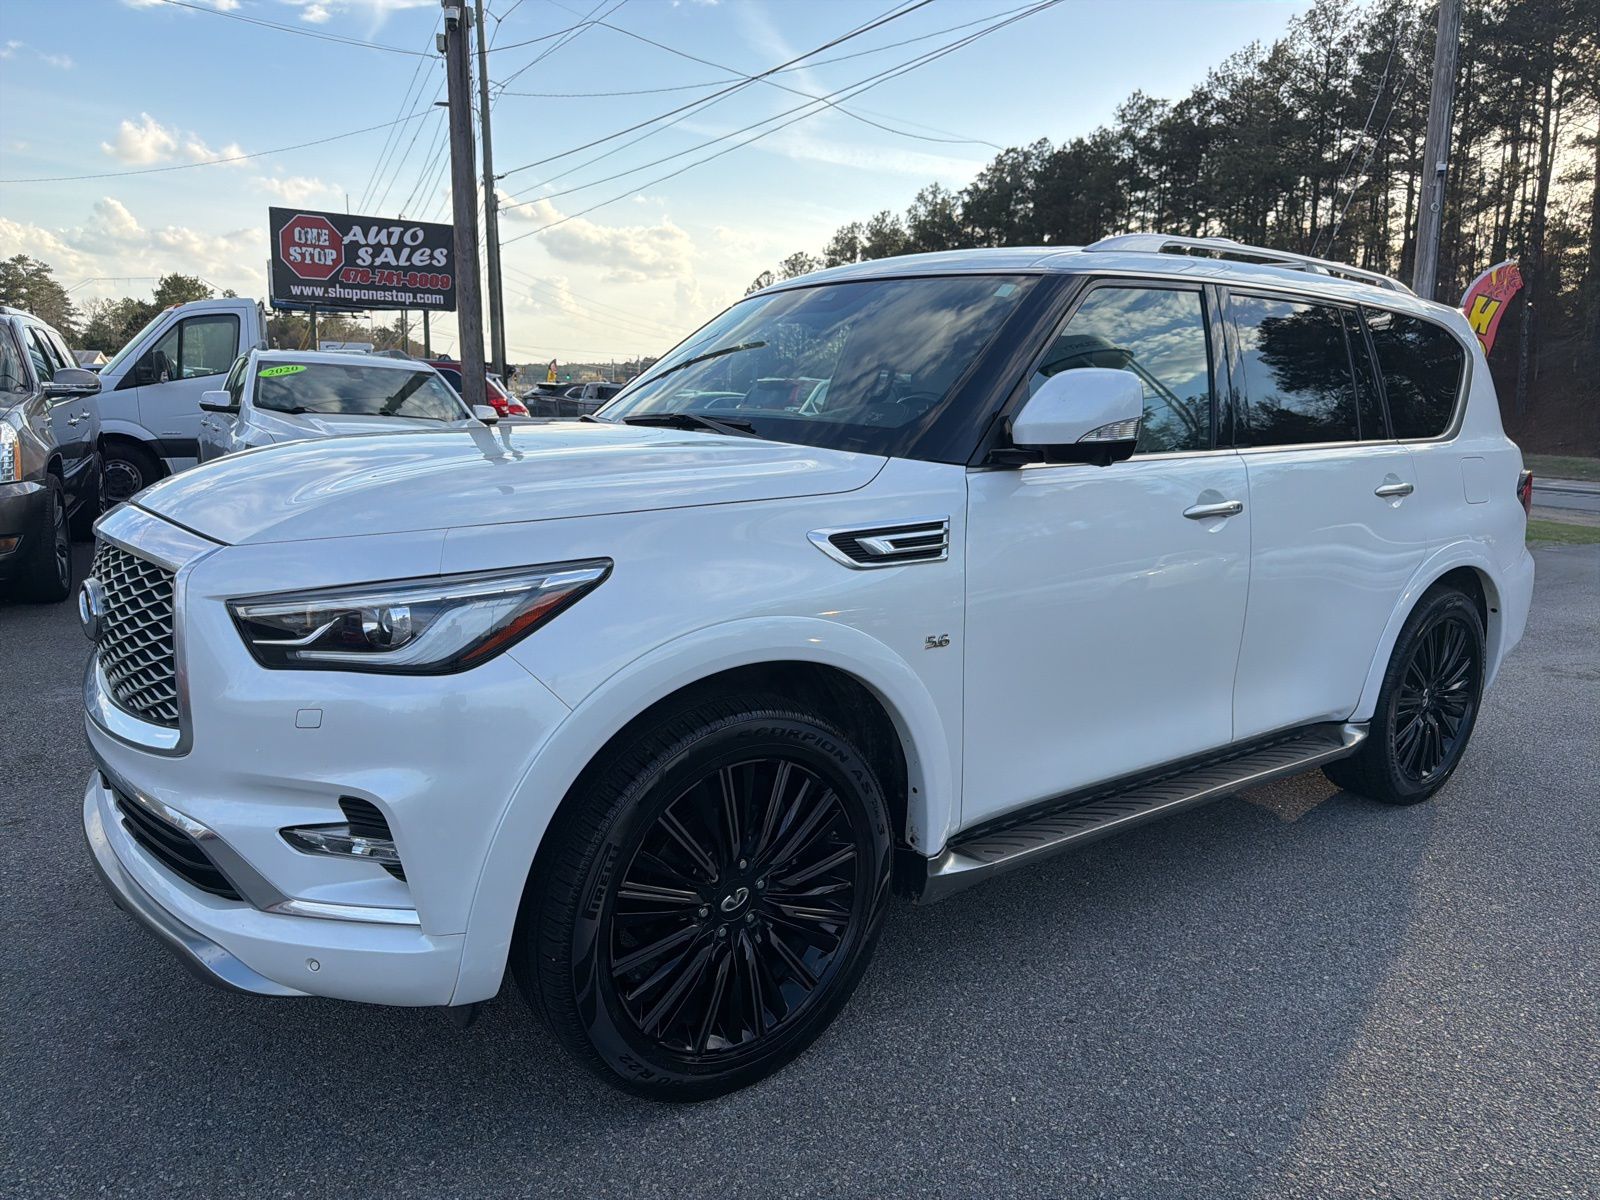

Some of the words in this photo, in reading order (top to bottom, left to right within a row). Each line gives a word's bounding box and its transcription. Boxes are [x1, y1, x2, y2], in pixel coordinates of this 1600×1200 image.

[294, 227, 330, 246] ONE
[289, 246, 337, 266] STOP
[290, 284, 444, 305] www.shoponestop.com
[267, 365, 299, 376] 2020
